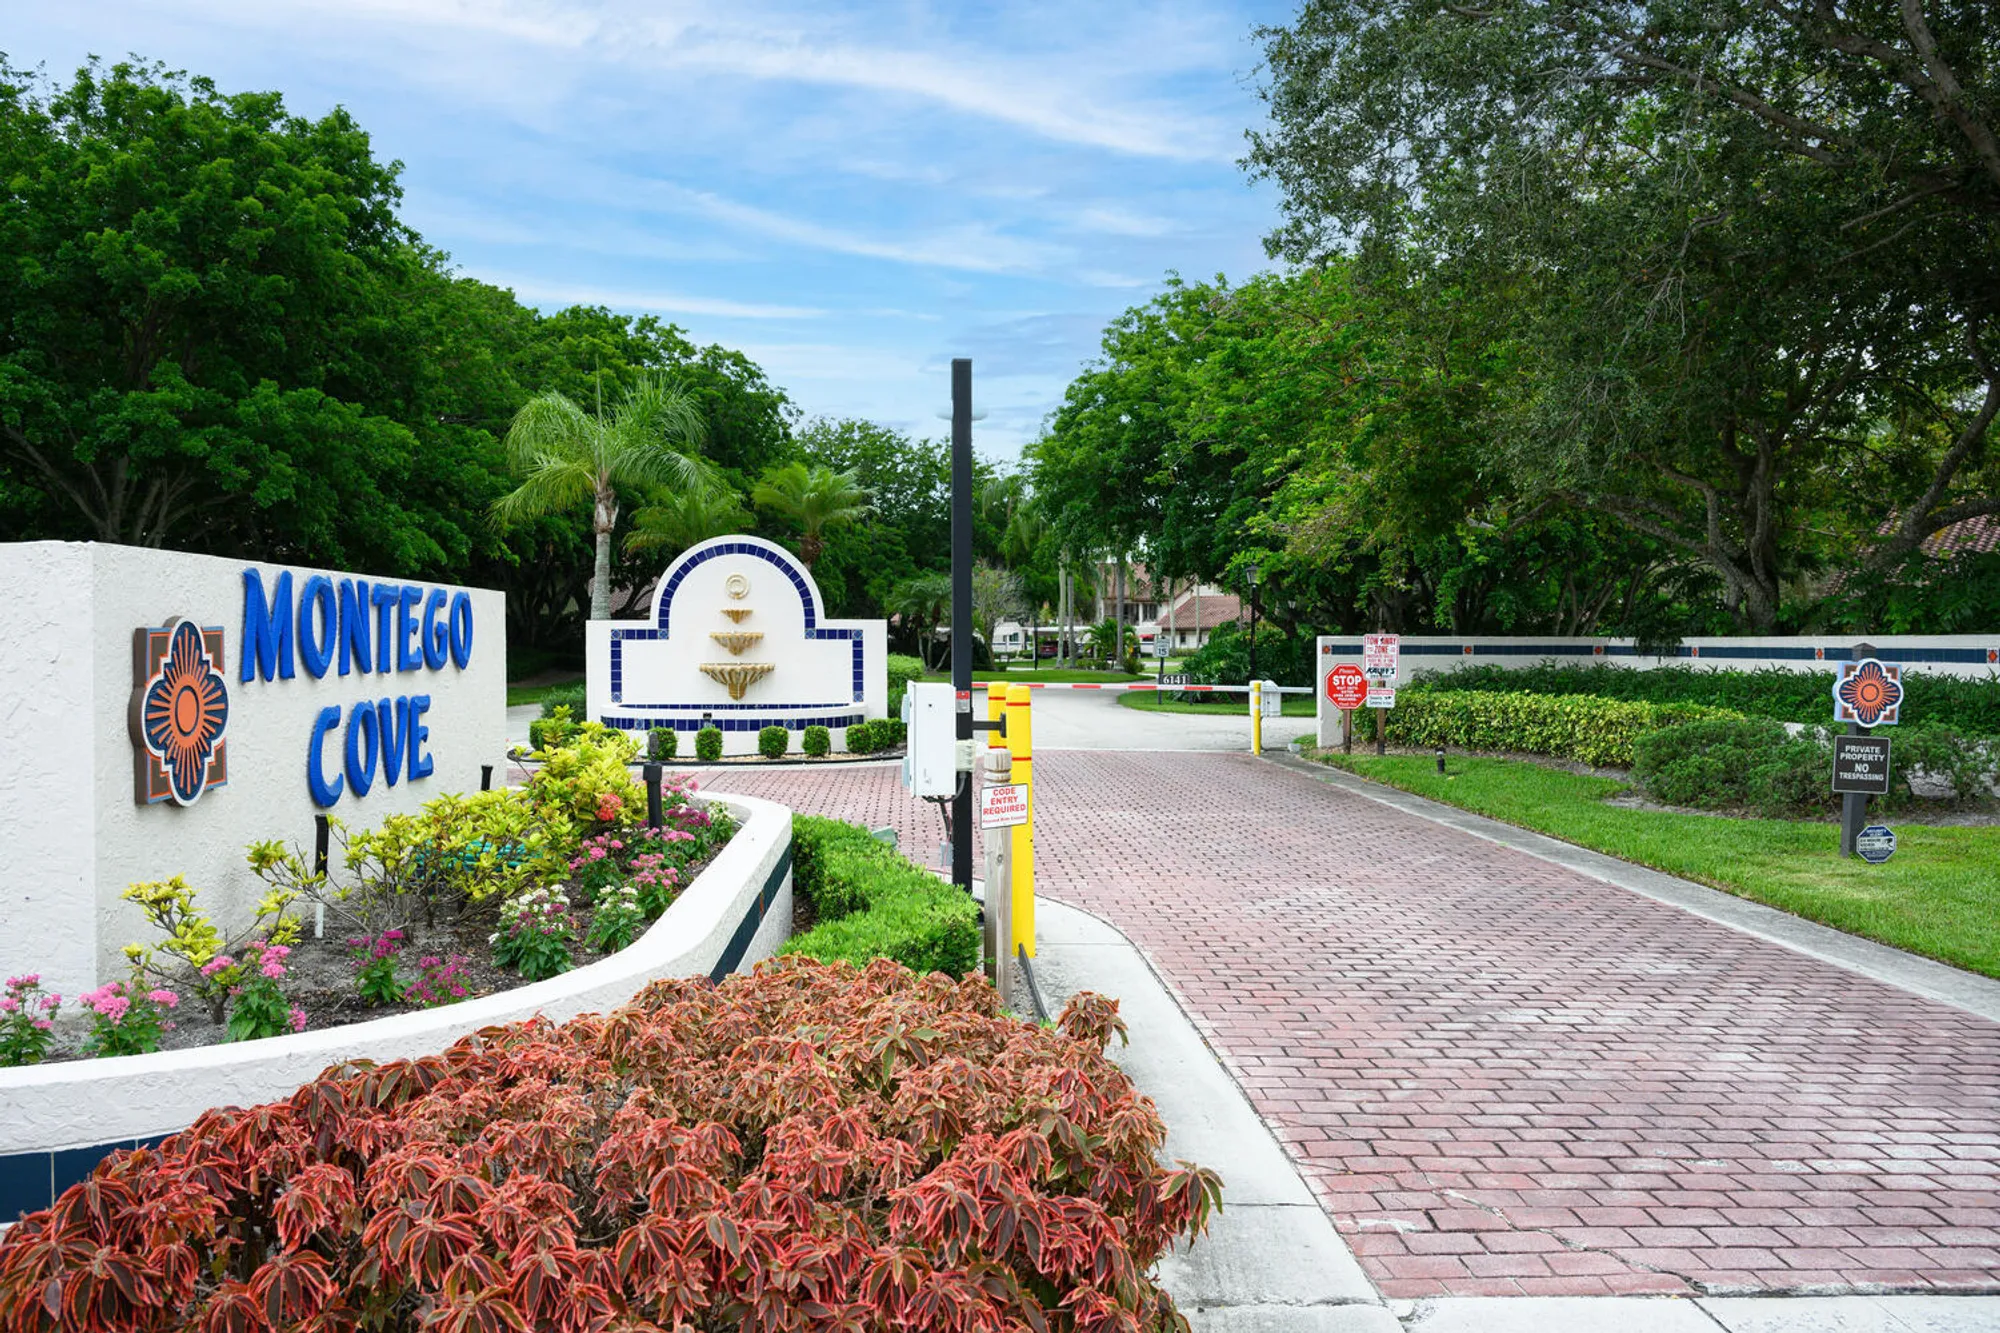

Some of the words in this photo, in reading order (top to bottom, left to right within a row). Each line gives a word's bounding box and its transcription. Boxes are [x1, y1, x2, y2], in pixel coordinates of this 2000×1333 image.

[241, 567, 473, 682] MONTEGO
[1163, 675, 1186, 684] 6141
[1333, 675, 1362, 685] STOP
[308, 694, 433, 808] COVE
[1845, 745, 1881, 754] PRIVATE
[1840, 752, 1885, 761] PROPERTY
[1855, 763, 1869, 773] NO
[1839, 772, 1884, 781] TRESPASSING
[993, 787, 1016, 796] CODE
[990, 796, 1018, 805] ENTRY
[983, 804, 1026, 814] REQUIRED
